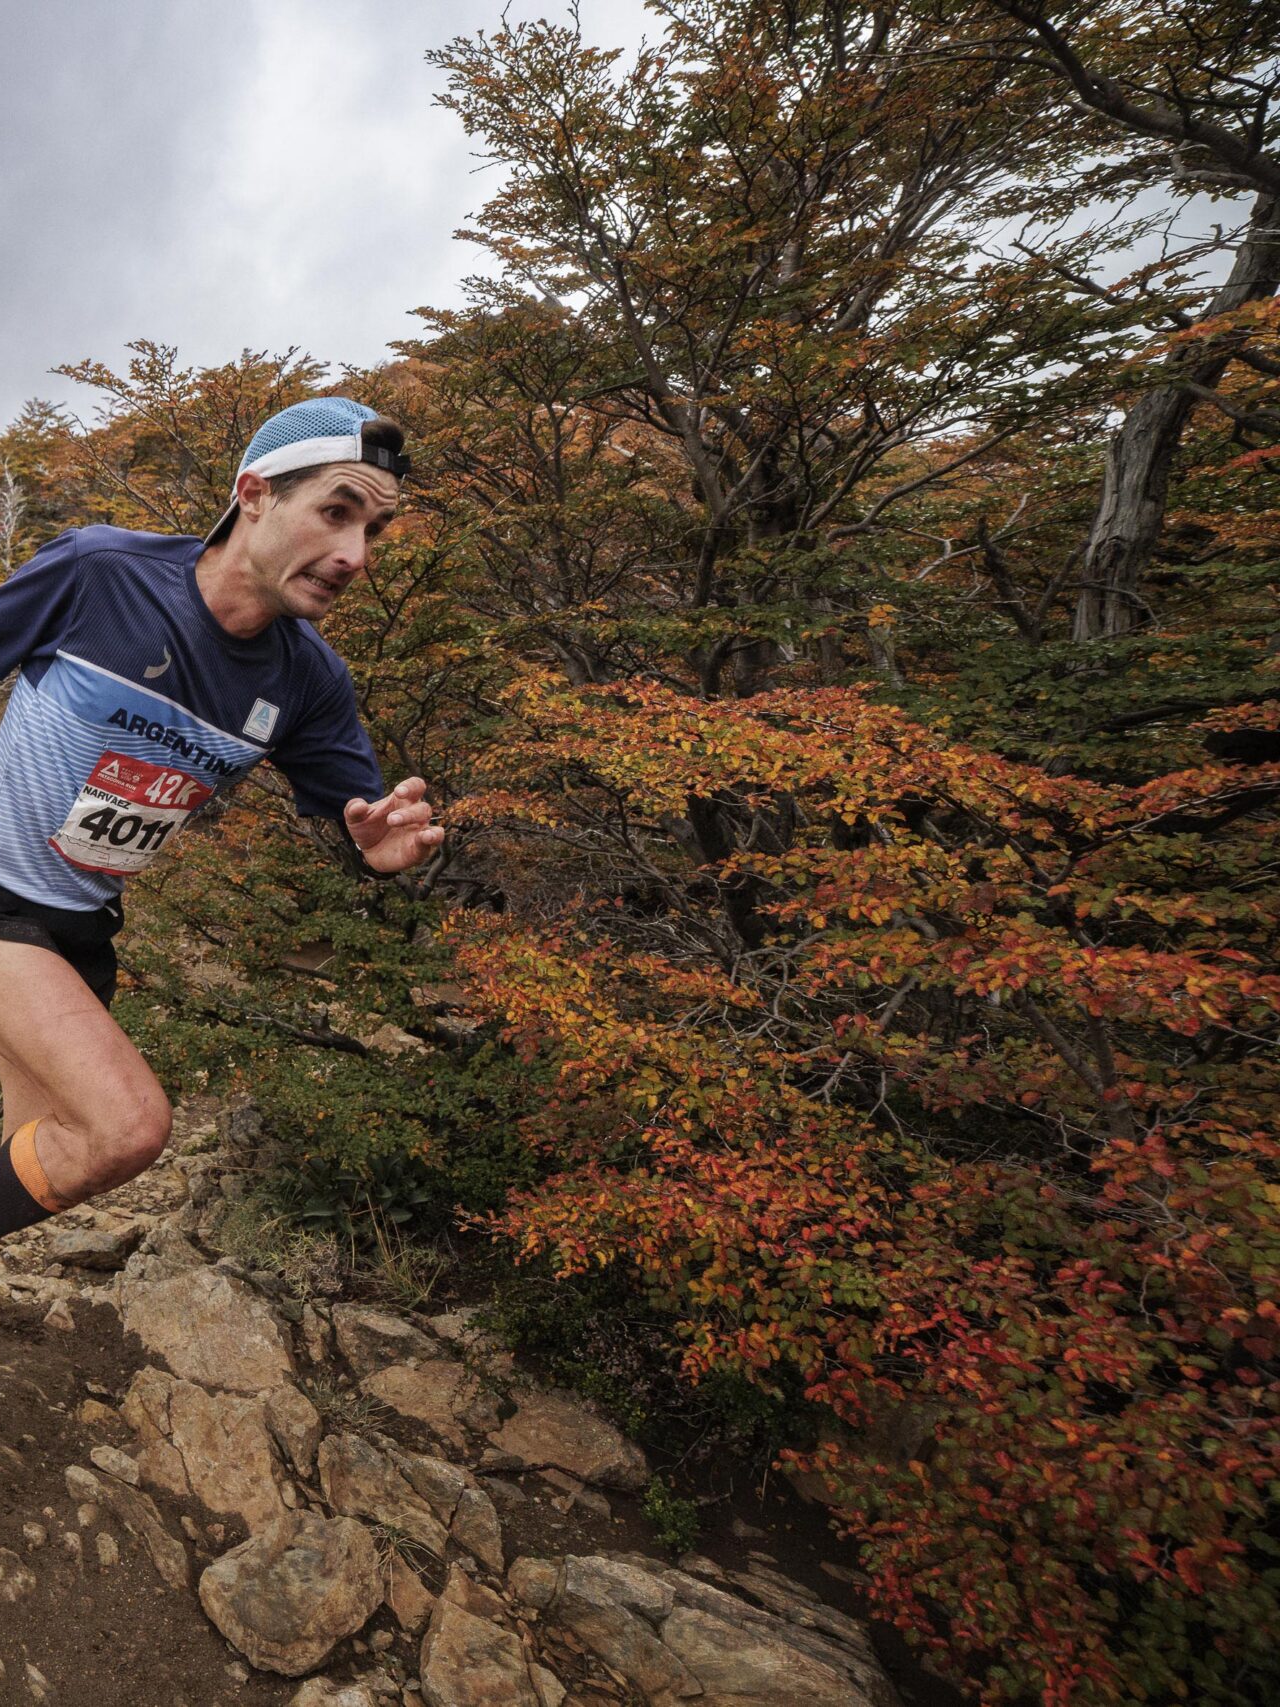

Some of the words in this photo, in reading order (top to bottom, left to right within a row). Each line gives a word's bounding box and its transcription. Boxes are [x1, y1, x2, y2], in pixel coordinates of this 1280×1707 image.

[83, 785, 132, 810] NARVAEZ
[144, 772, 201, 806] 42K
[79, 806, 176, 851] 4011
